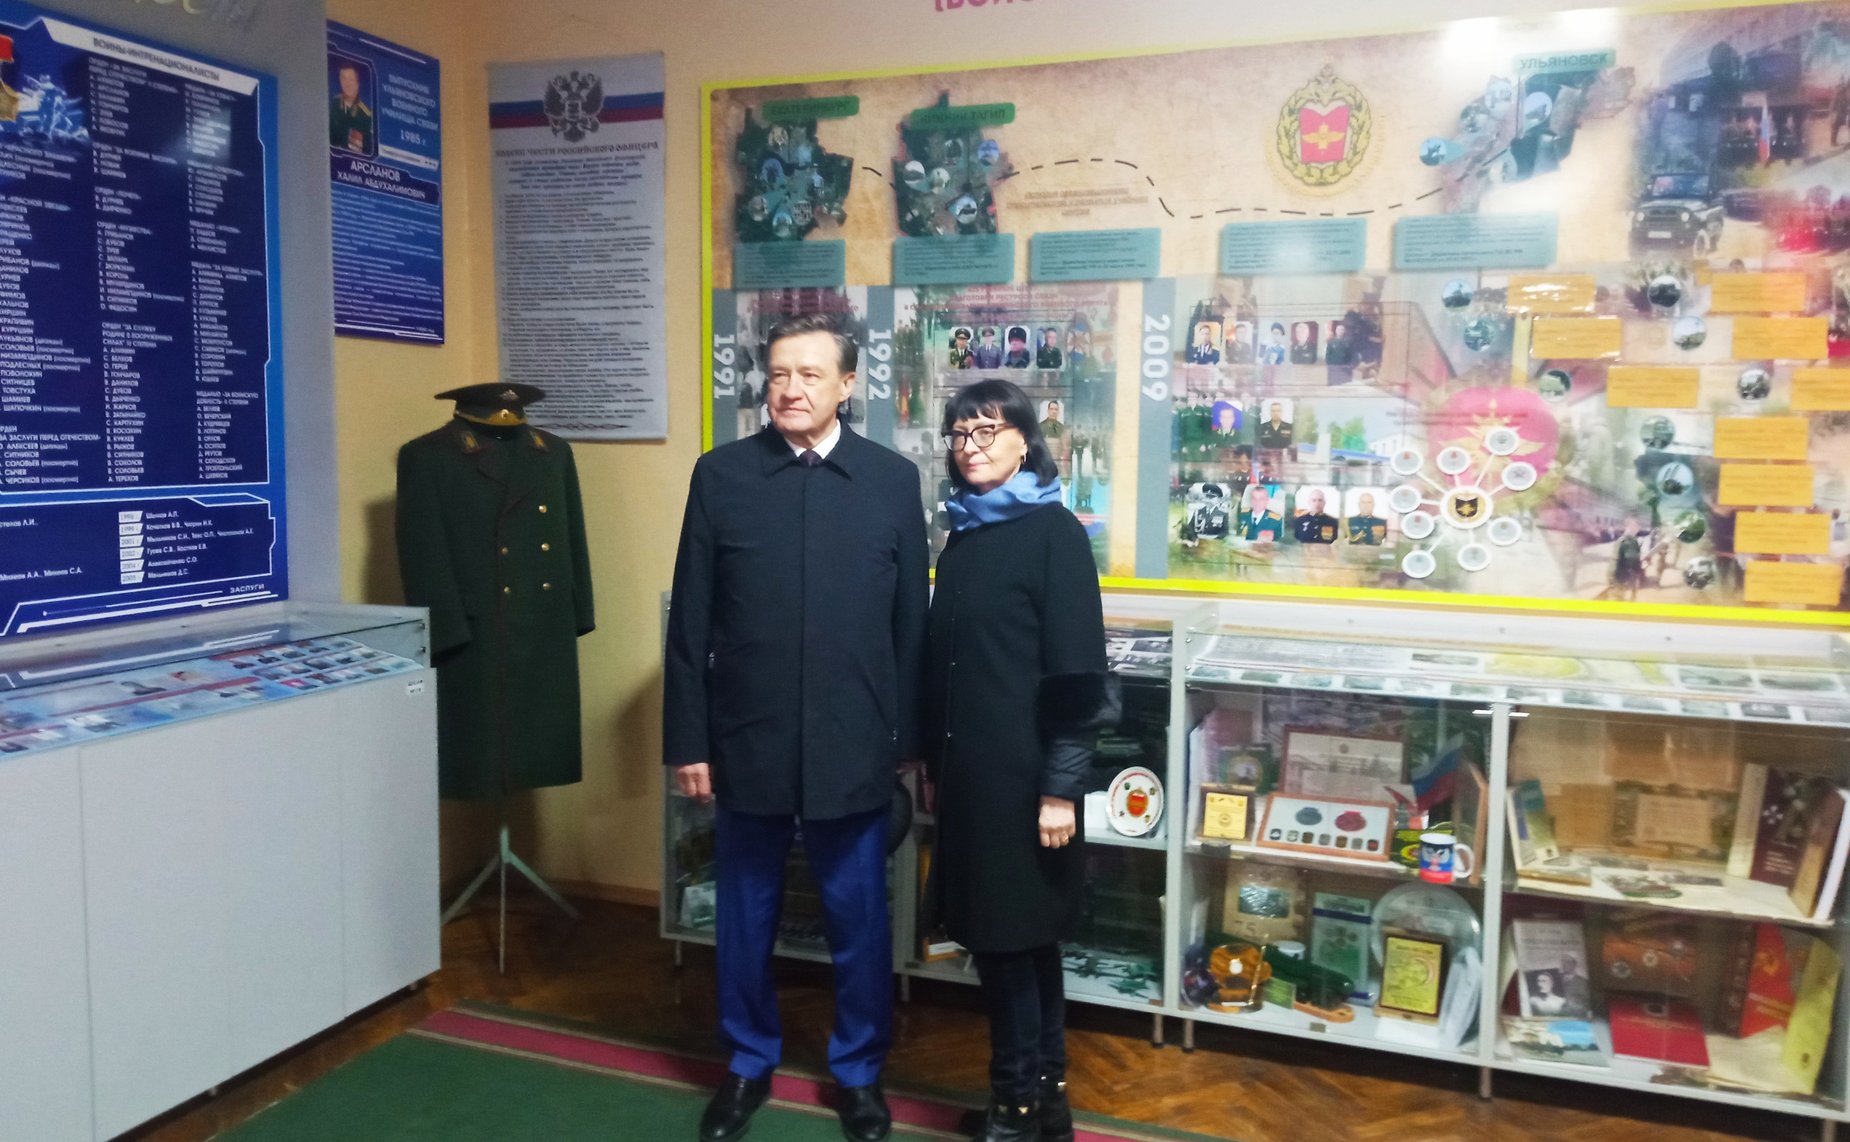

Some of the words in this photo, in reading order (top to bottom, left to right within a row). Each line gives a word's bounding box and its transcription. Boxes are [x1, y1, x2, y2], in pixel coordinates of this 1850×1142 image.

[1520, 53, 1607, 69] УЛЬЯНОВСК
[351, 160, 400, 182] АРСЛАНОВ
[364, 177, 425, 199] АБДУХАЛИМОВИЧ
[713, 333, 735, 399] 1991
[868, 328, 891, 401] 1992
[1141, 313, 1170, 401] 2009
[230, 584, 265, 594] ЗАСЛУГИ
